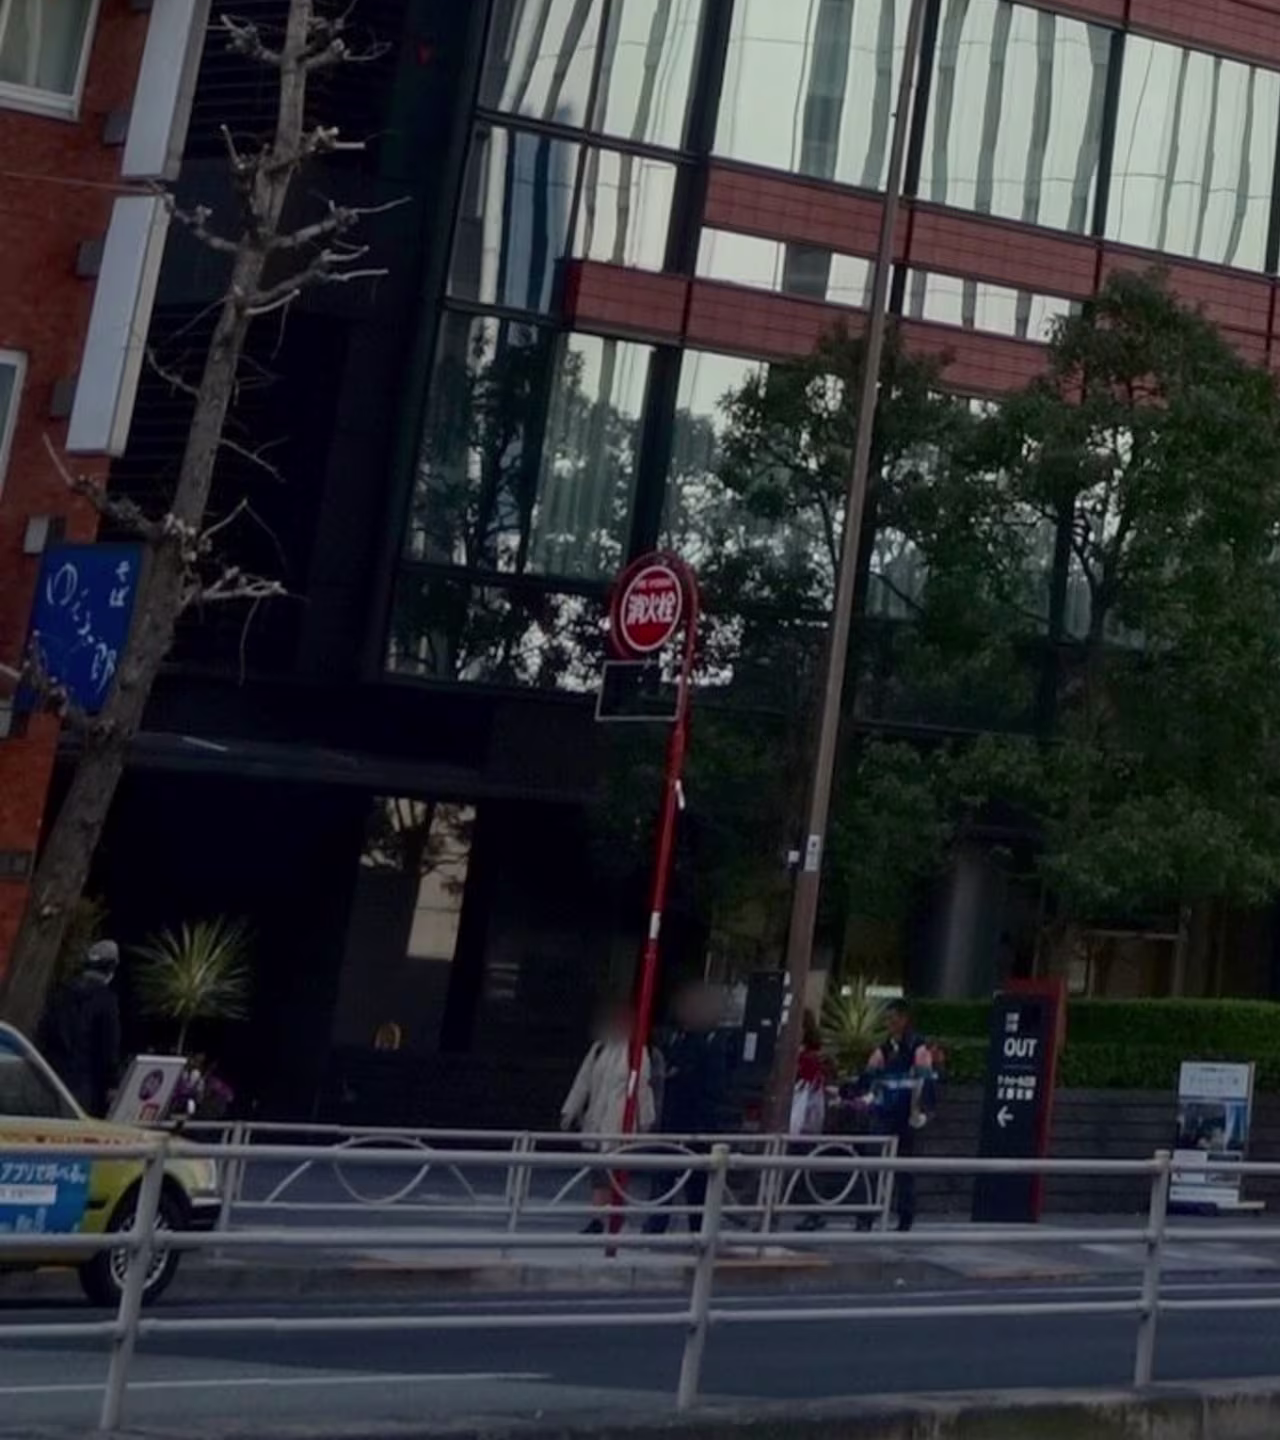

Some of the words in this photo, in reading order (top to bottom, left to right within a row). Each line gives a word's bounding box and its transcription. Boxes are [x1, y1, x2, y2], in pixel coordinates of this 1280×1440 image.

[626, 591, 676, 626] 消火栓
[1003, 1037, 1038, 1058] OUT
